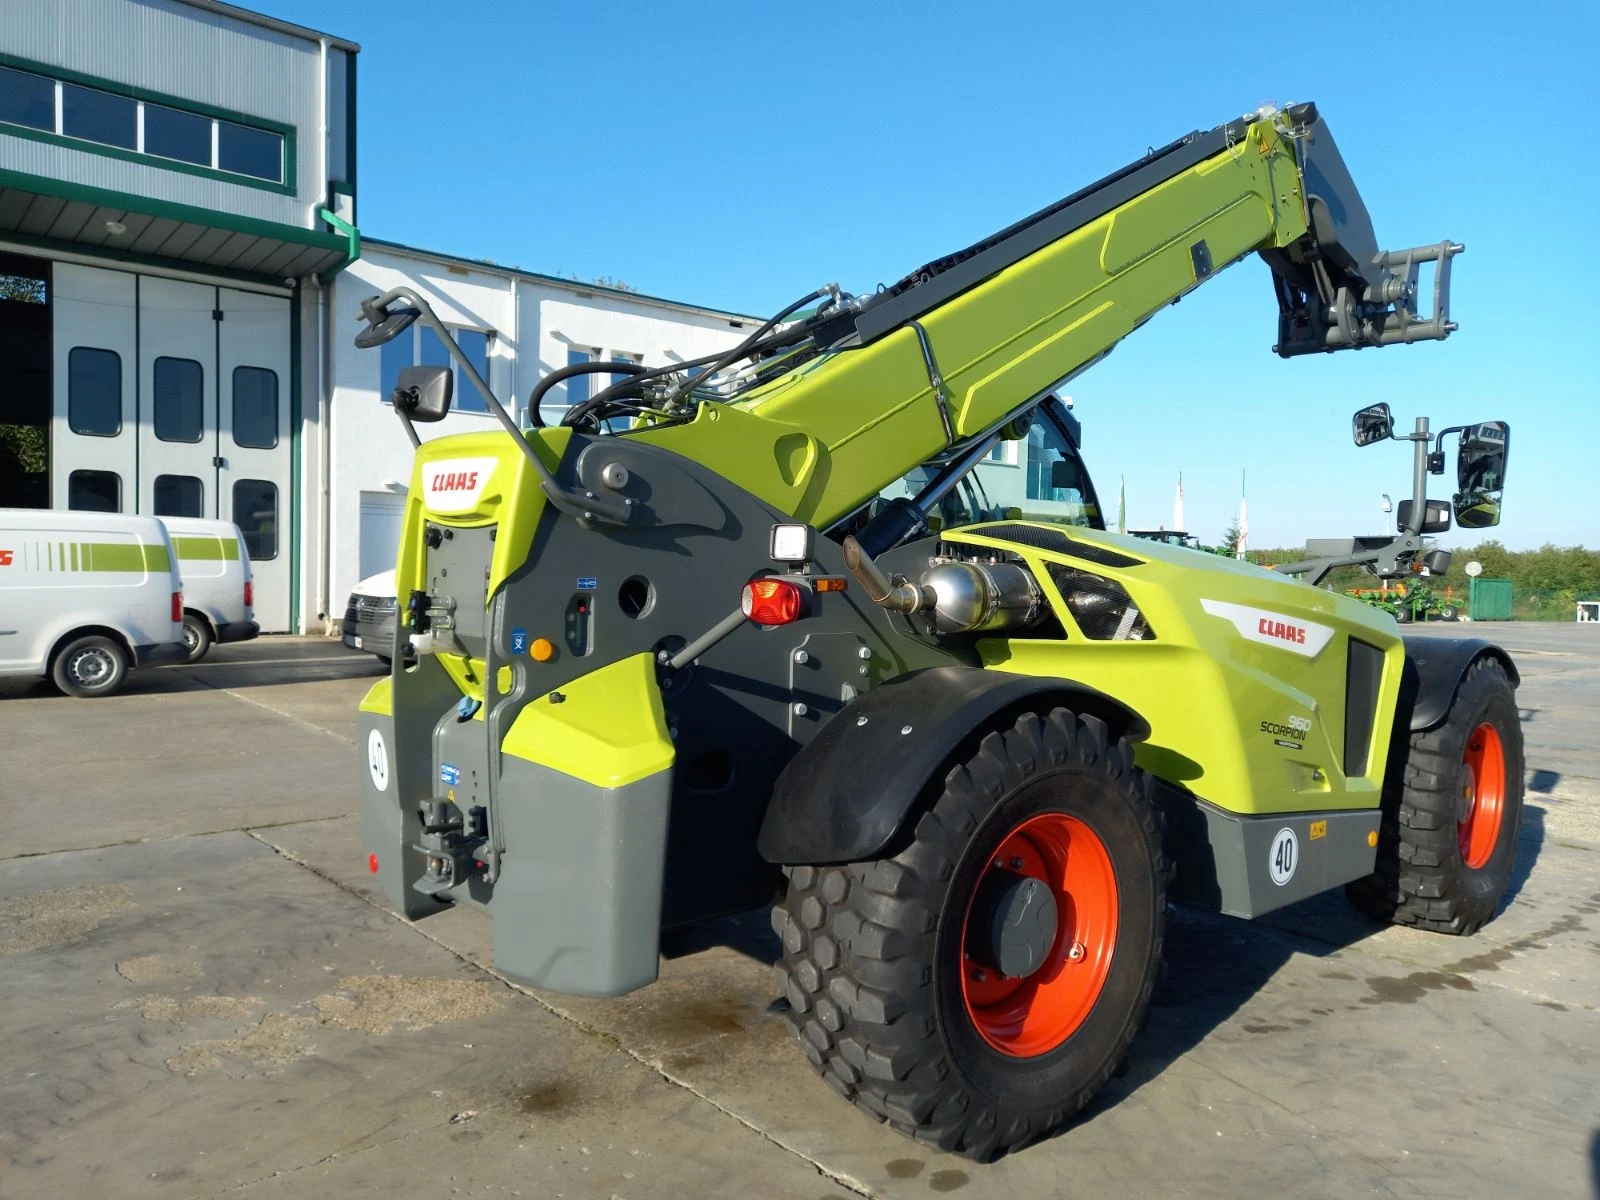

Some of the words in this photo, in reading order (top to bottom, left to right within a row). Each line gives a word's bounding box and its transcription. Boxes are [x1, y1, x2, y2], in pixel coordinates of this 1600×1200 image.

[432, 471, 478, 491] CLAAS
[1259, 618, 1306, 644] CLAAS
[1260, 720, 1306, 741] SCORPION
[1275, 838, 1293, 874] 40
